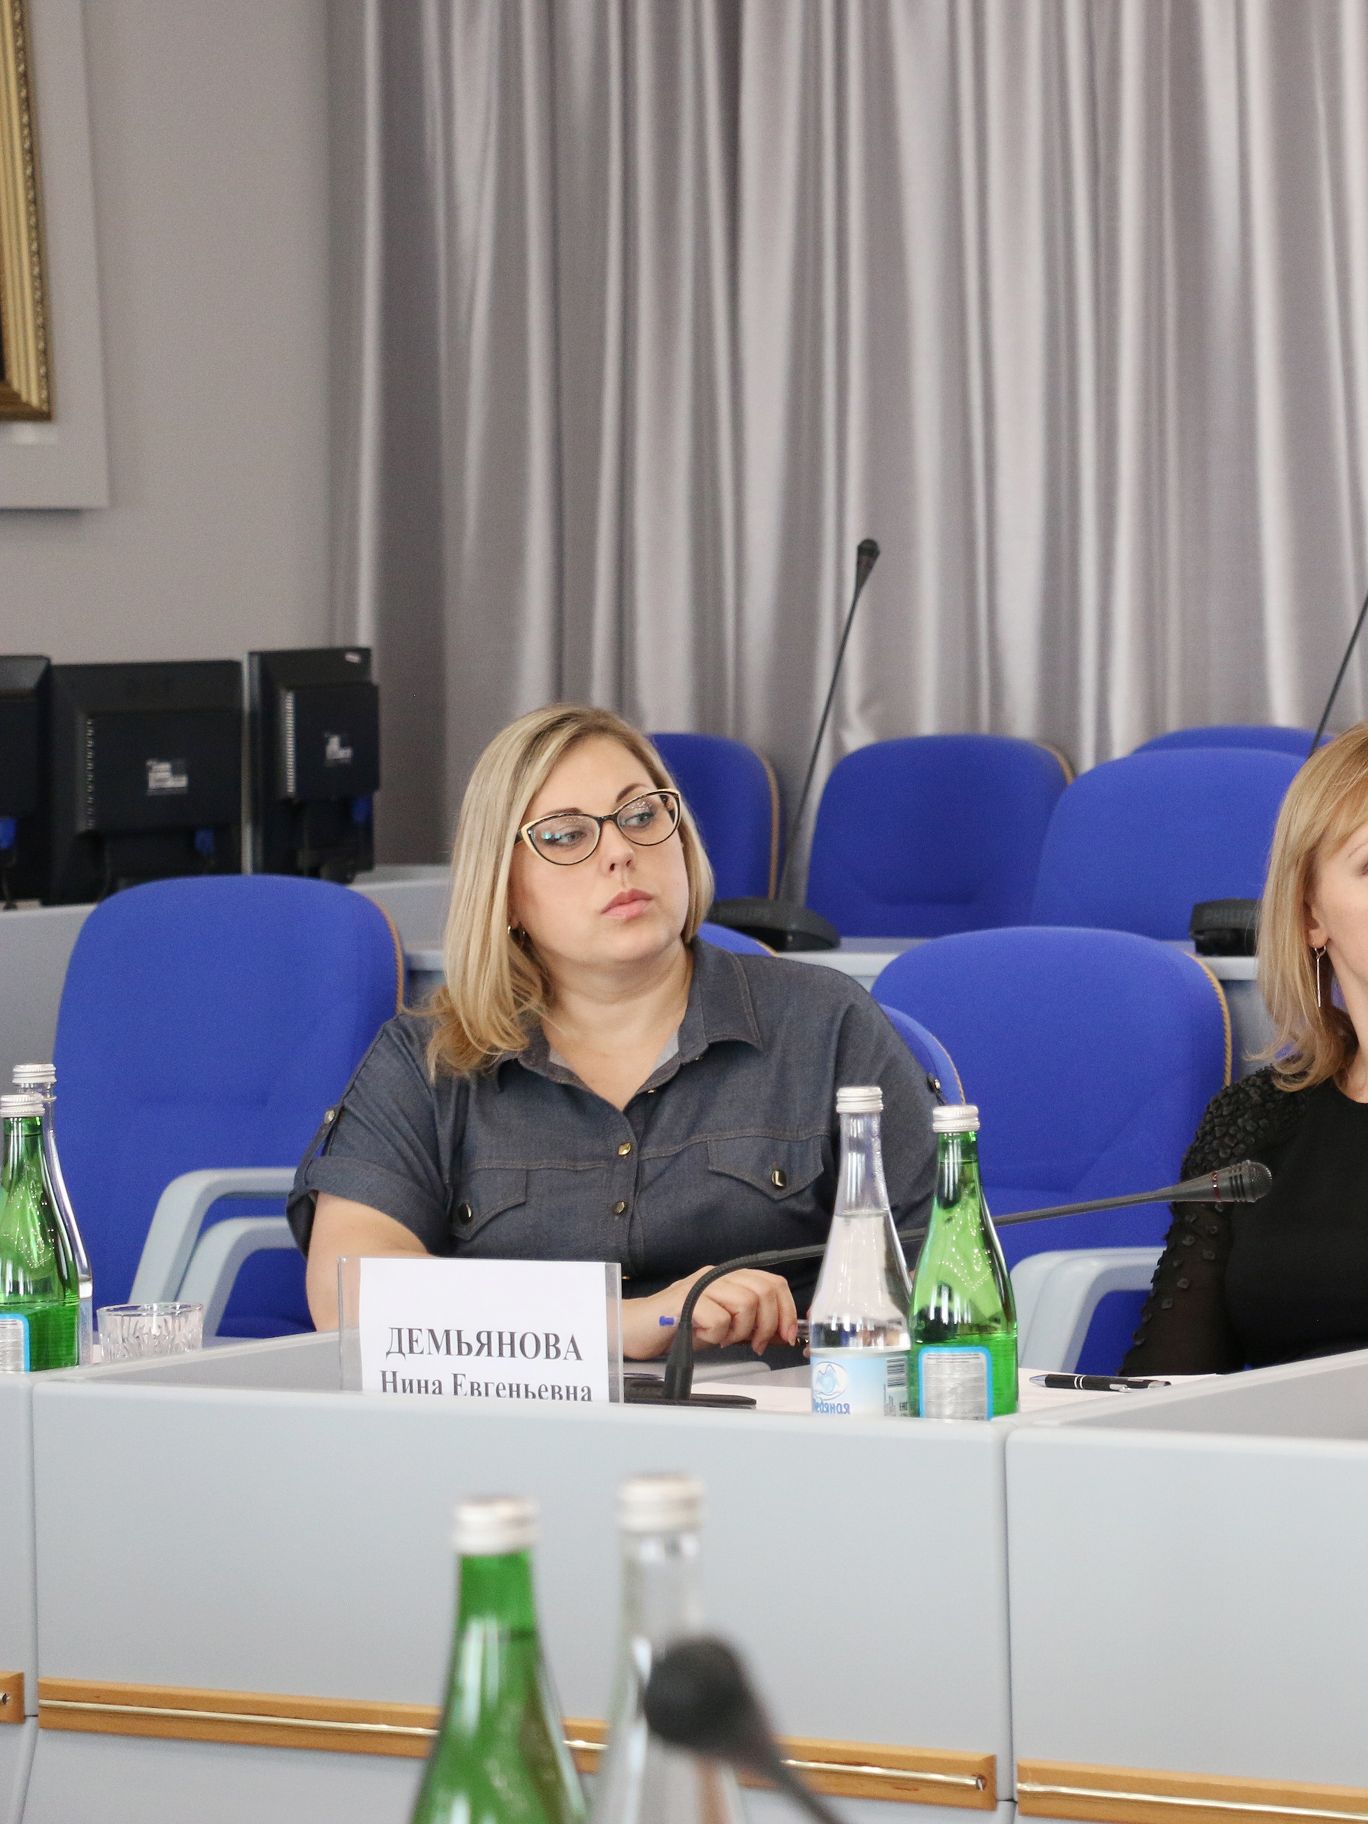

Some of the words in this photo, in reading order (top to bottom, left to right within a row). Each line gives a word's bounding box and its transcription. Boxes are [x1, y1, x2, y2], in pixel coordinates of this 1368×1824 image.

[385, 1327, 583, 1361] ДЕМЬЯНОВА
[380, 1370, 443, 1395] Нина
[452, 1373, 592, 1402] Евгеньевна
